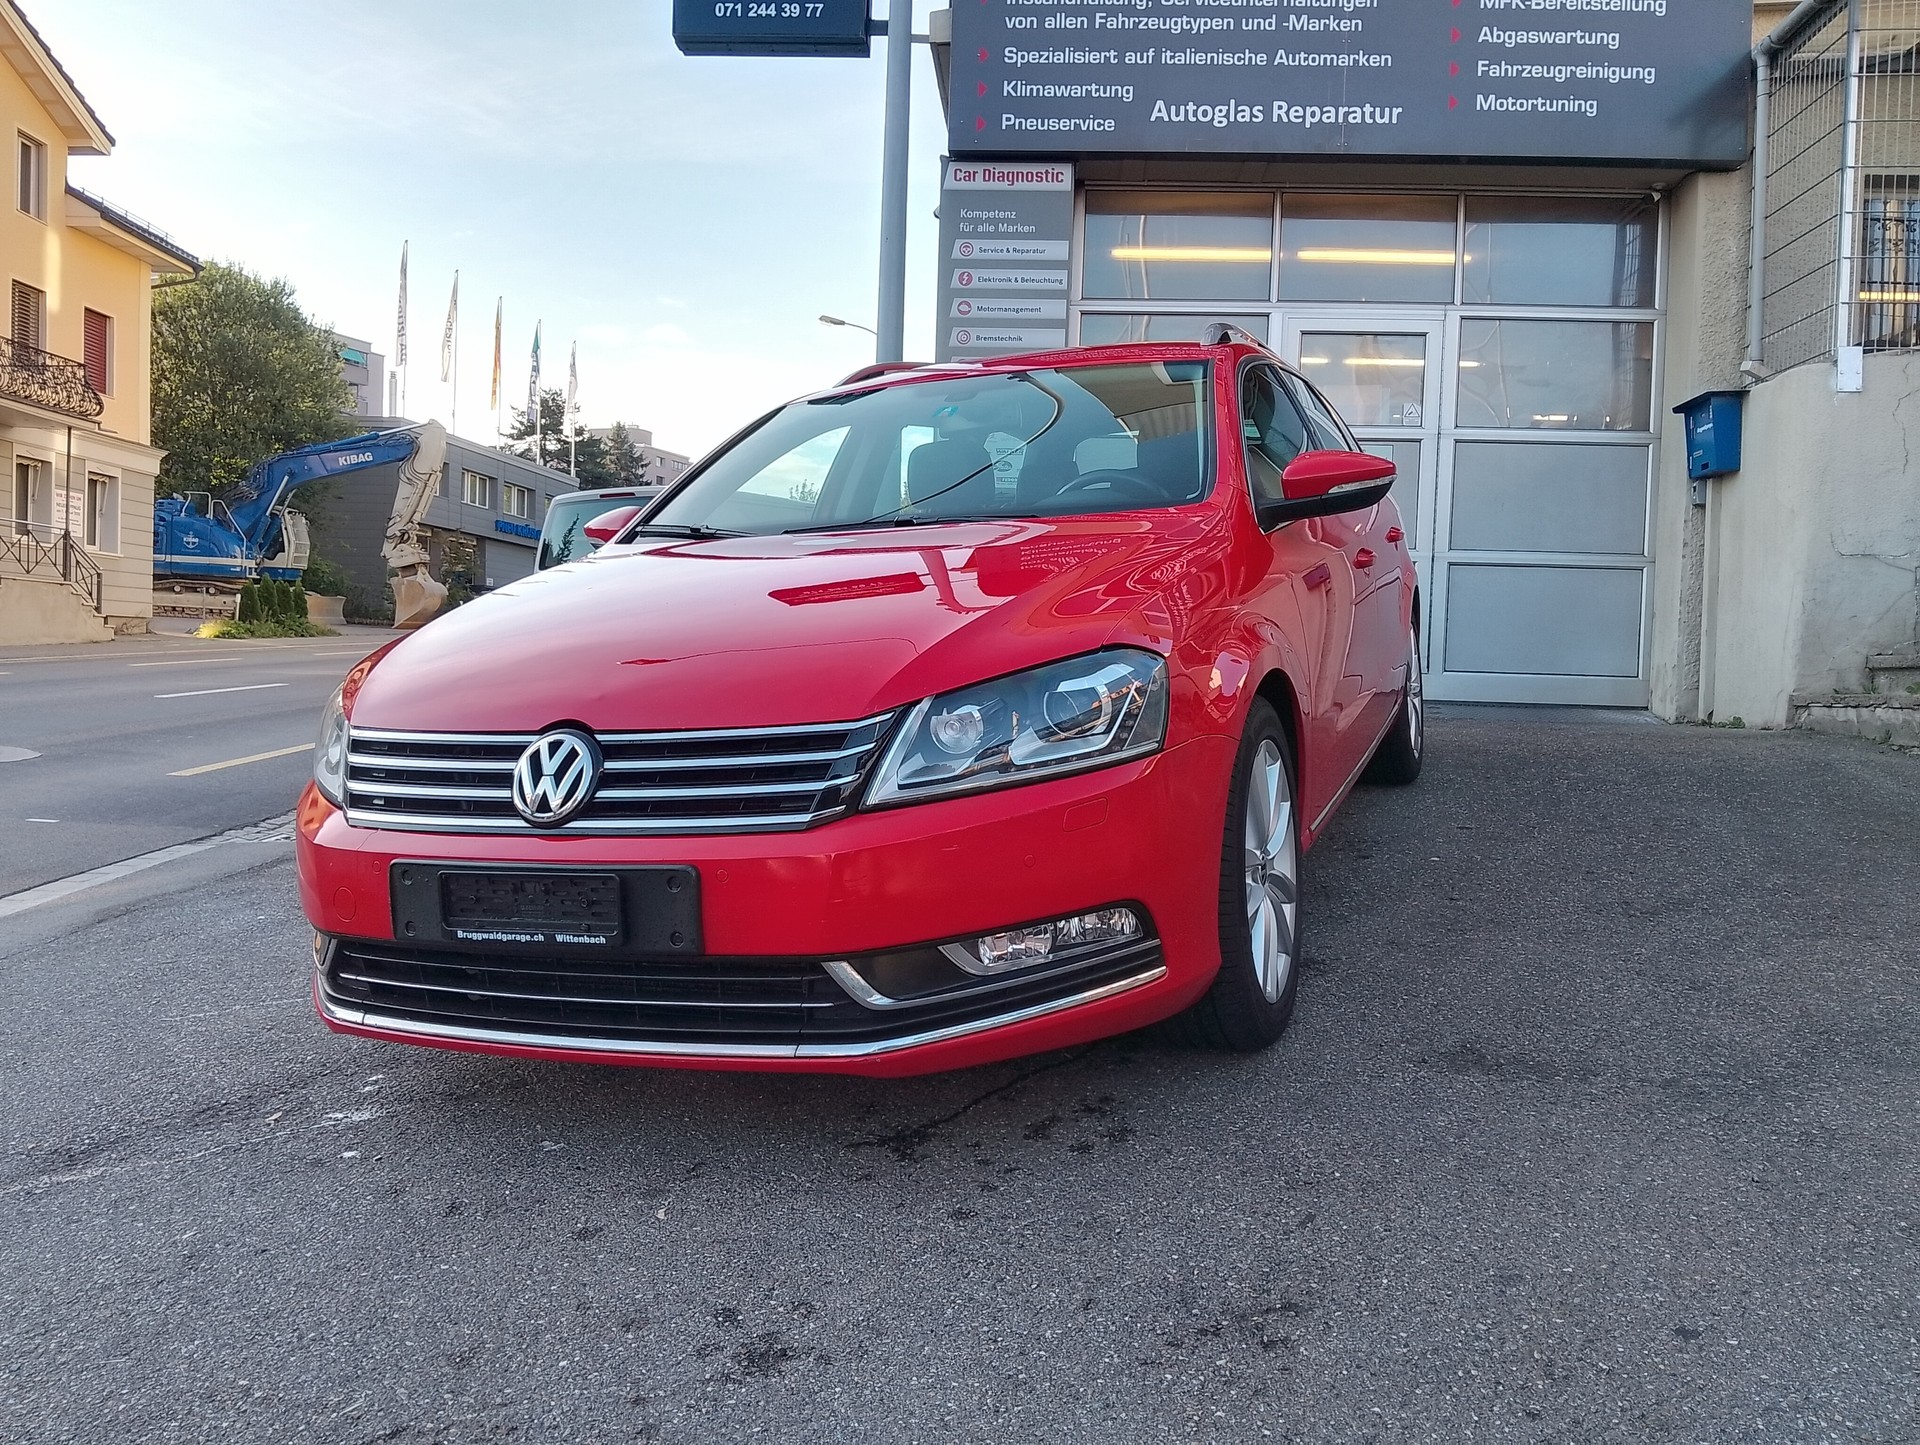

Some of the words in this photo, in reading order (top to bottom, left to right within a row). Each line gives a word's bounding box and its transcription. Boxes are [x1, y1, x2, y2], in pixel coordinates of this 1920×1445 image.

[715, 2, 742, 17] 071
[747, 3, 777, 17] 244
[781, 3, 800, 17] 39
[804, 3, 824, 17] 77
[1005, 16, 1037, 29] von
[1044, 13, 1088, 29] allen
[1095, 13, 1234, 34] Fahrzeugtypen
[1241, 14, 1276, 31] und
[1283, 14, 1362, 31] -Marken
[1477, 26, 1620, 49] Abgaswartung
[1004, 47, 1118, 67] Spezialisiert
[1124, 48, 1155, 64] auf
[1161, 48, 1267, 66] italienische
[1273, 49, 1392, 67] Automarken
[1477, 60, 1656, 84] Fahrzeugreinigung
[1003, 80, 1134, 102] Klimawartung
[1150, 99, 1264, 127] Autoglas
[1272, 100, 1403, 129] Reparatur
[1476, 94, 1598, 117] Motortuning
[1001, 113, 1115, 131] Pneuservice
[953, 168, 978, 182] Car
[982, 167, 1064, 186] Diagnostic
[960, 208, 1016, 220] Kompetenz
[959, 223, 974, 232] für
[977, 223, 995, 233] alle
[998, 224, 1036, 233] Marken
[978, 246, 1005, 254] Service
[1012, 247, 1046, 256] Reparatur
[977, 276, 1013, 284] Elektronik
[1020, 277, 1064, 285] Beleuchtung
[976, 305, 1042, 314] Motormanagement
[975, 335, 1023, 343] Bremstechnik
[338, 452, 373, 466] KIBAG
[515, 732, 591, 821] VW
[457, 930, 545, 942] Bruggwaldgarage.ch
[555, 933, 606, 944] Wittenbach
